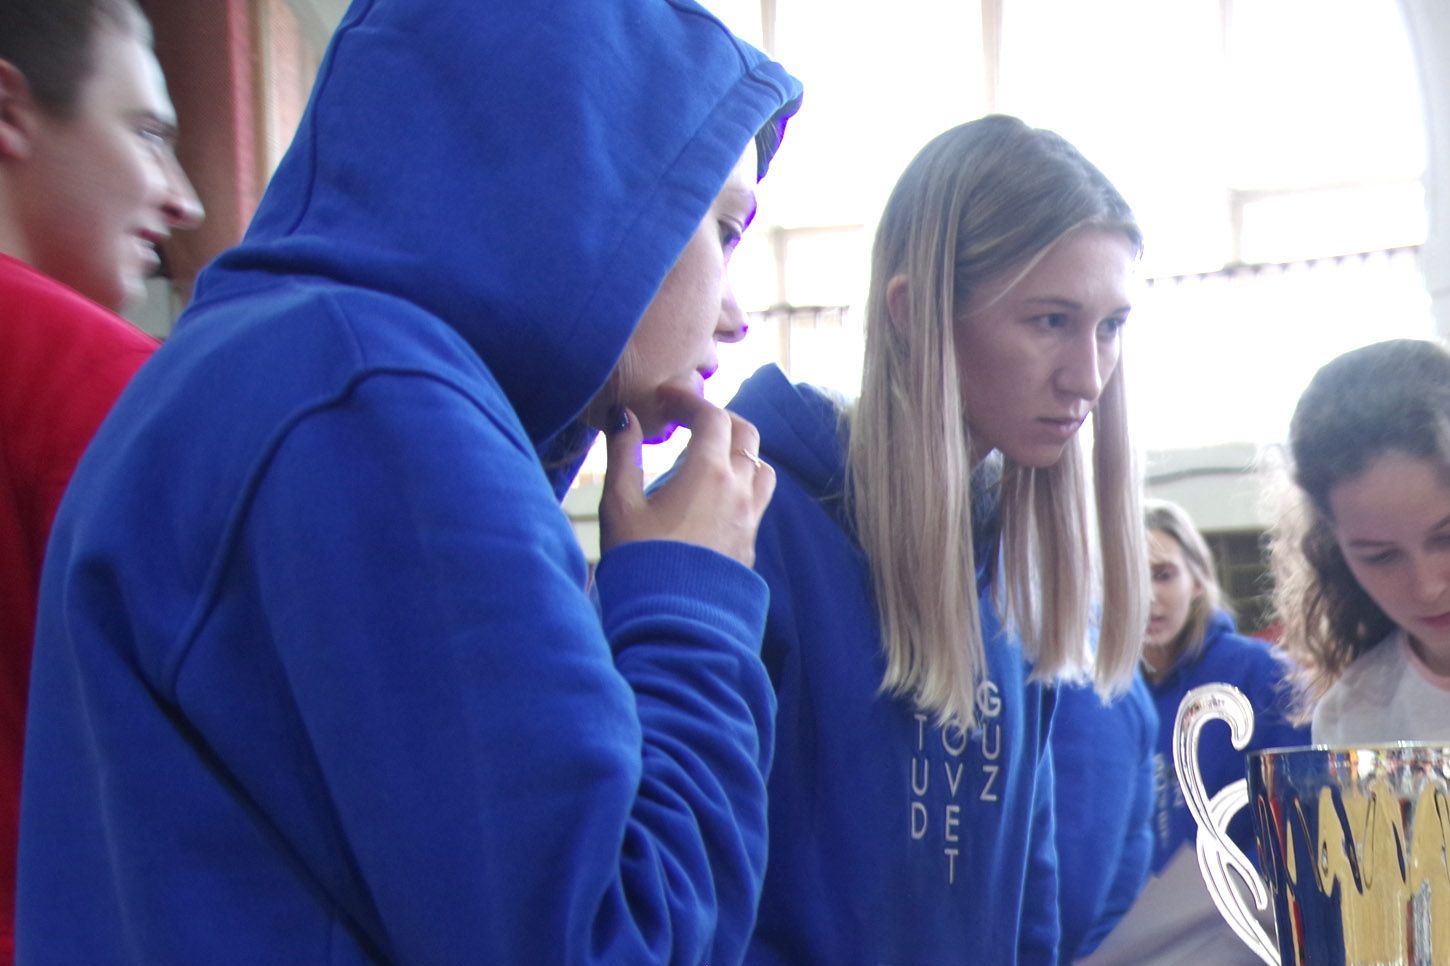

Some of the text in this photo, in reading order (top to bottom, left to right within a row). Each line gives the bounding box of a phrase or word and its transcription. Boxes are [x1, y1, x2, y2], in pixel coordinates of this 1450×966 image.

[911, 712, 930, 840] TUD
[941, 715, 968, 884] OVET
[975, 680, 1001, 801] GUZ
